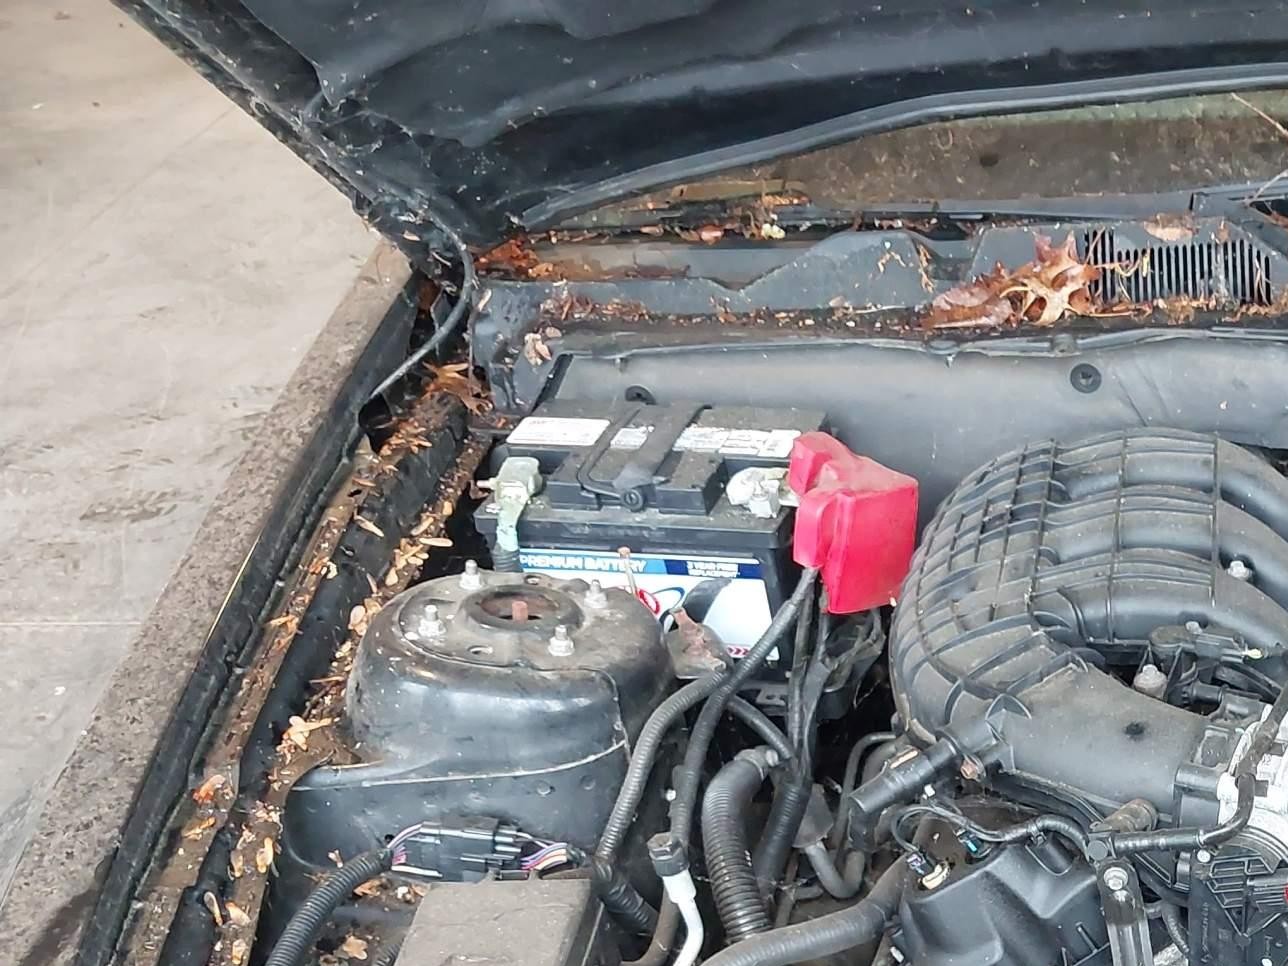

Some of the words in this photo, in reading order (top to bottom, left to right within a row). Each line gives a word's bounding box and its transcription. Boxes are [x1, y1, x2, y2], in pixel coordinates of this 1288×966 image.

[519, 555, 583, 569] PREMIUM
[585, 557, 647, 572] BATTERY
[693, 561, 715, 570] YEAR
